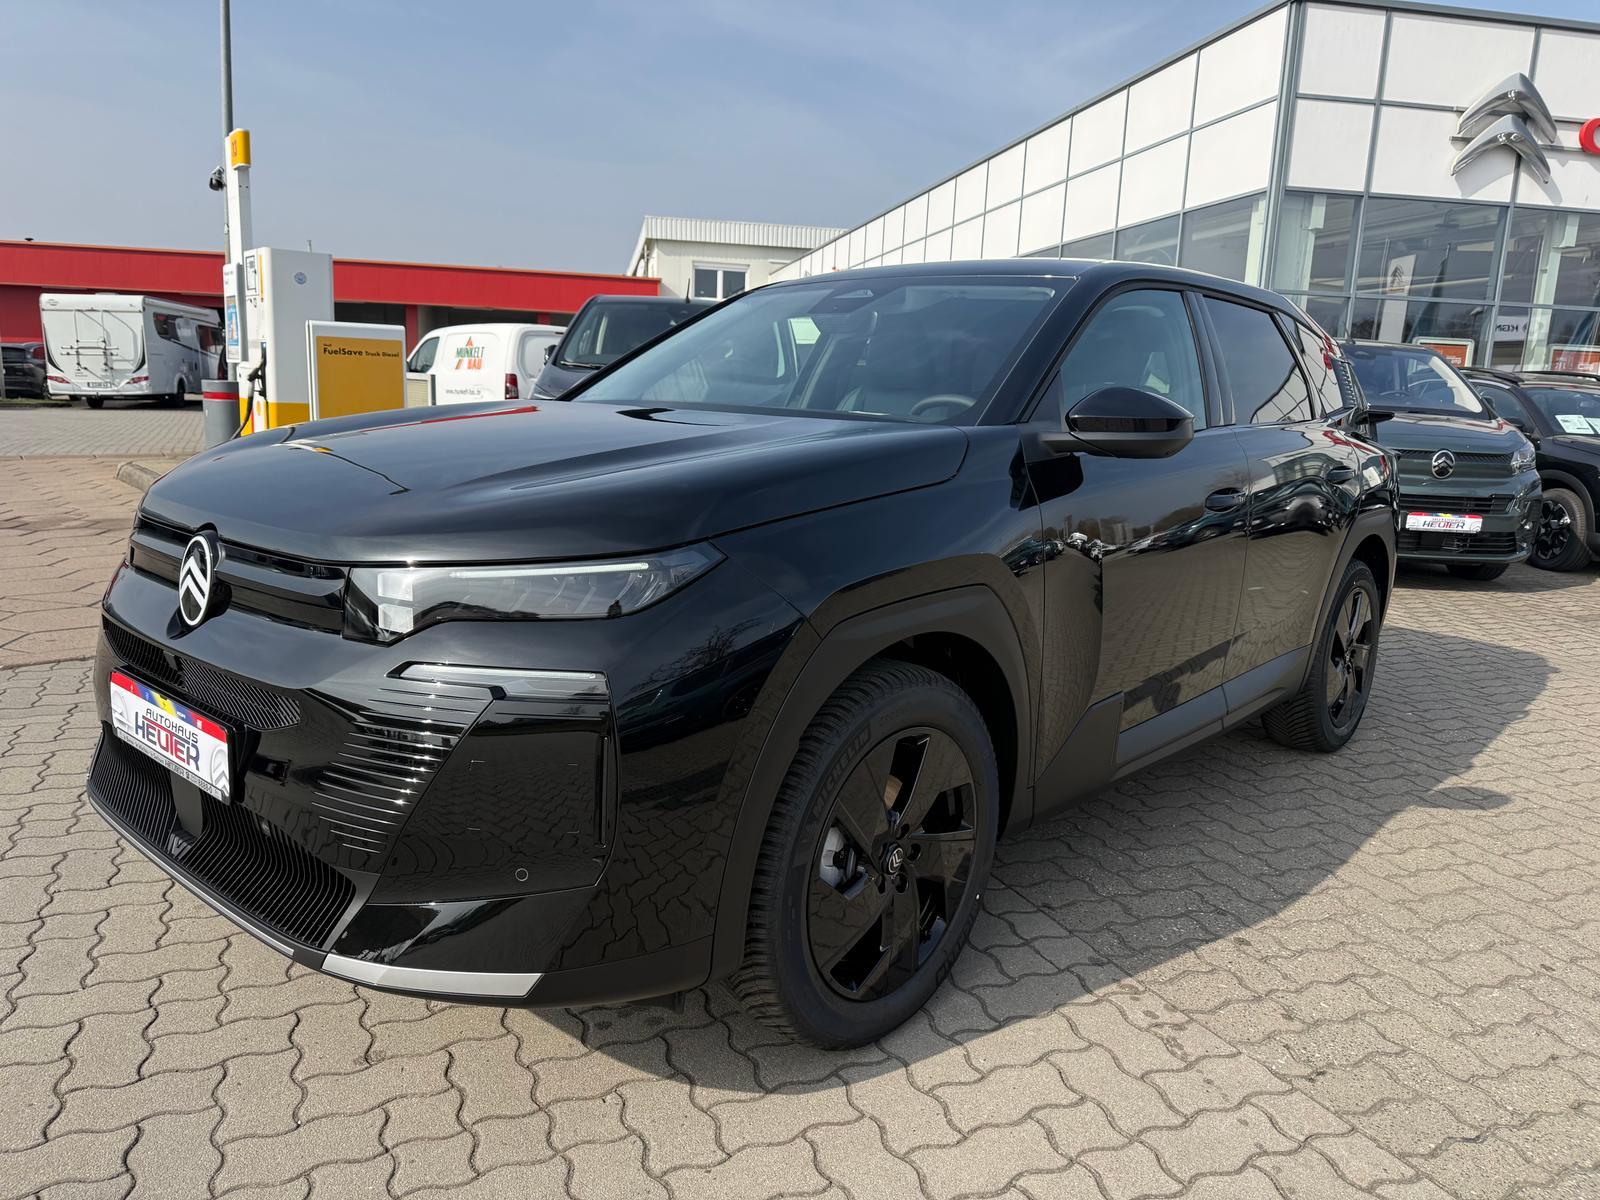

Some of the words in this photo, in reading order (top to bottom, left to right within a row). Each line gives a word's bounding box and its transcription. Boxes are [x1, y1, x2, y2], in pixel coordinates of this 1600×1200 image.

[323, 347, 363, 356] FuelSave
[467, 358, 482, 370] BAU
[135, 711, 200, 771] HEUTER
[145, 708, 199, 743] AUTOHAUS
[812, 724, 871, 819] MICHELIN
